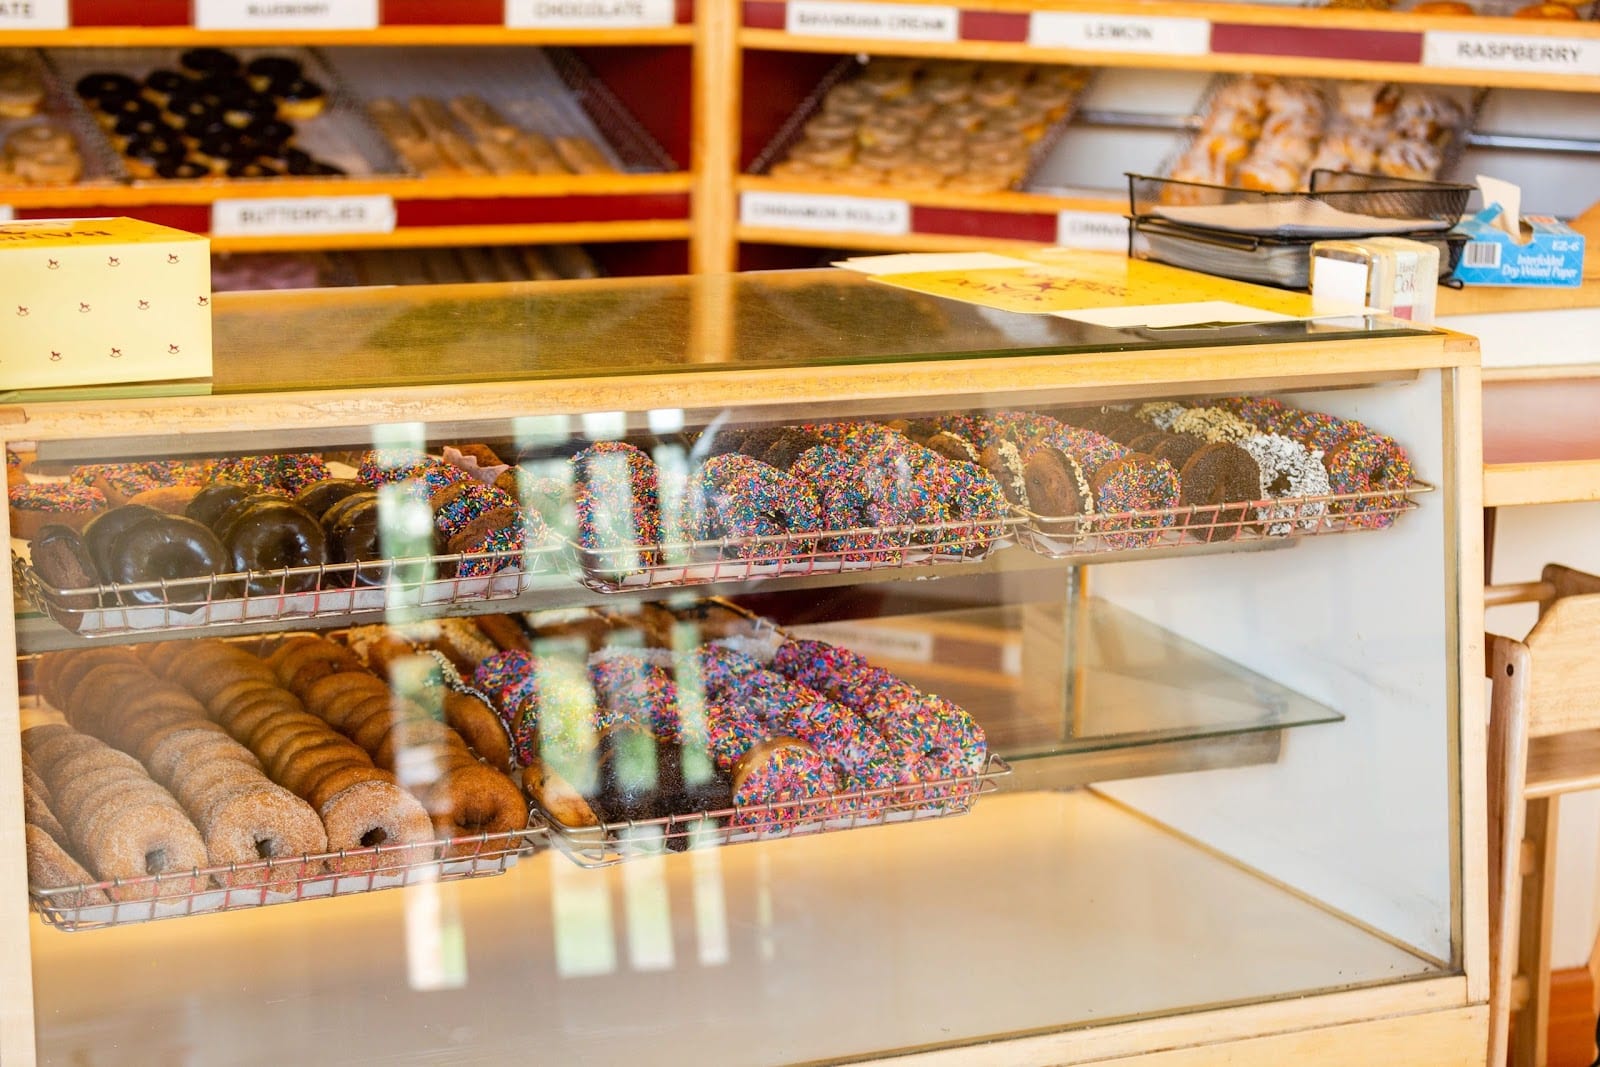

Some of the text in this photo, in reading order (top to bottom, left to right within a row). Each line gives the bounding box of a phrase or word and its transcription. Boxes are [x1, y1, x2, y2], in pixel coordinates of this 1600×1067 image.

[533, 1, 644, 18] CHOCOLATE
[888, 15, 945, 31] CREAM
[1083, 23, 1152, 40] LEMON
[1457, 41, 1581, 63] RASPBERRY
[239, 206, 365, 226] BUTTERFLIES
[1502, 263, 1520, 279] Dry
[1552, 265, 1579, 280] Paper
